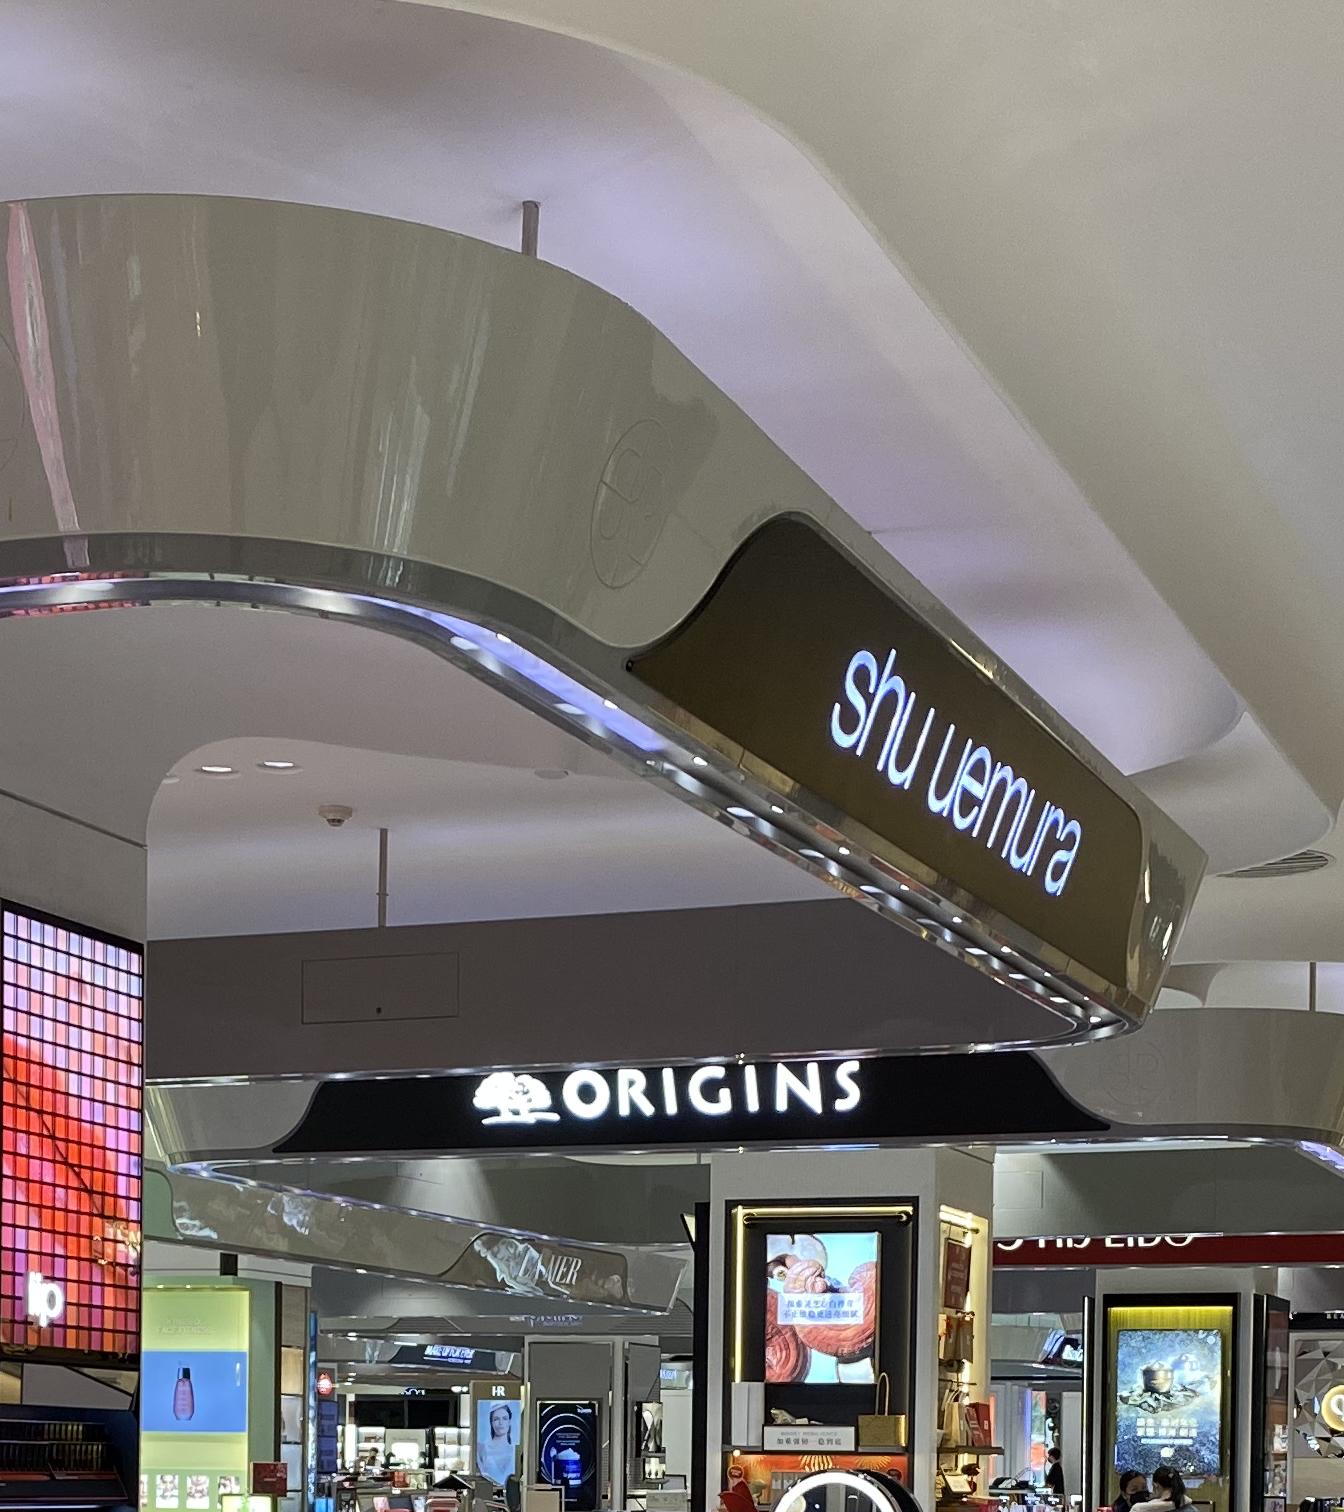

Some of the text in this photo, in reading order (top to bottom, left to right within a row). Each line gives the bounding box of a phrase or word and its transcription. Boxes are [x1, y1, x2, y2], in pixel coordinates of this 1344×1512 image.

[831, 648, 1082, 896] shu uemura
[562, 1060, 861, 1120] ORIGINS
[28, 1271, 65, 1327] lip
